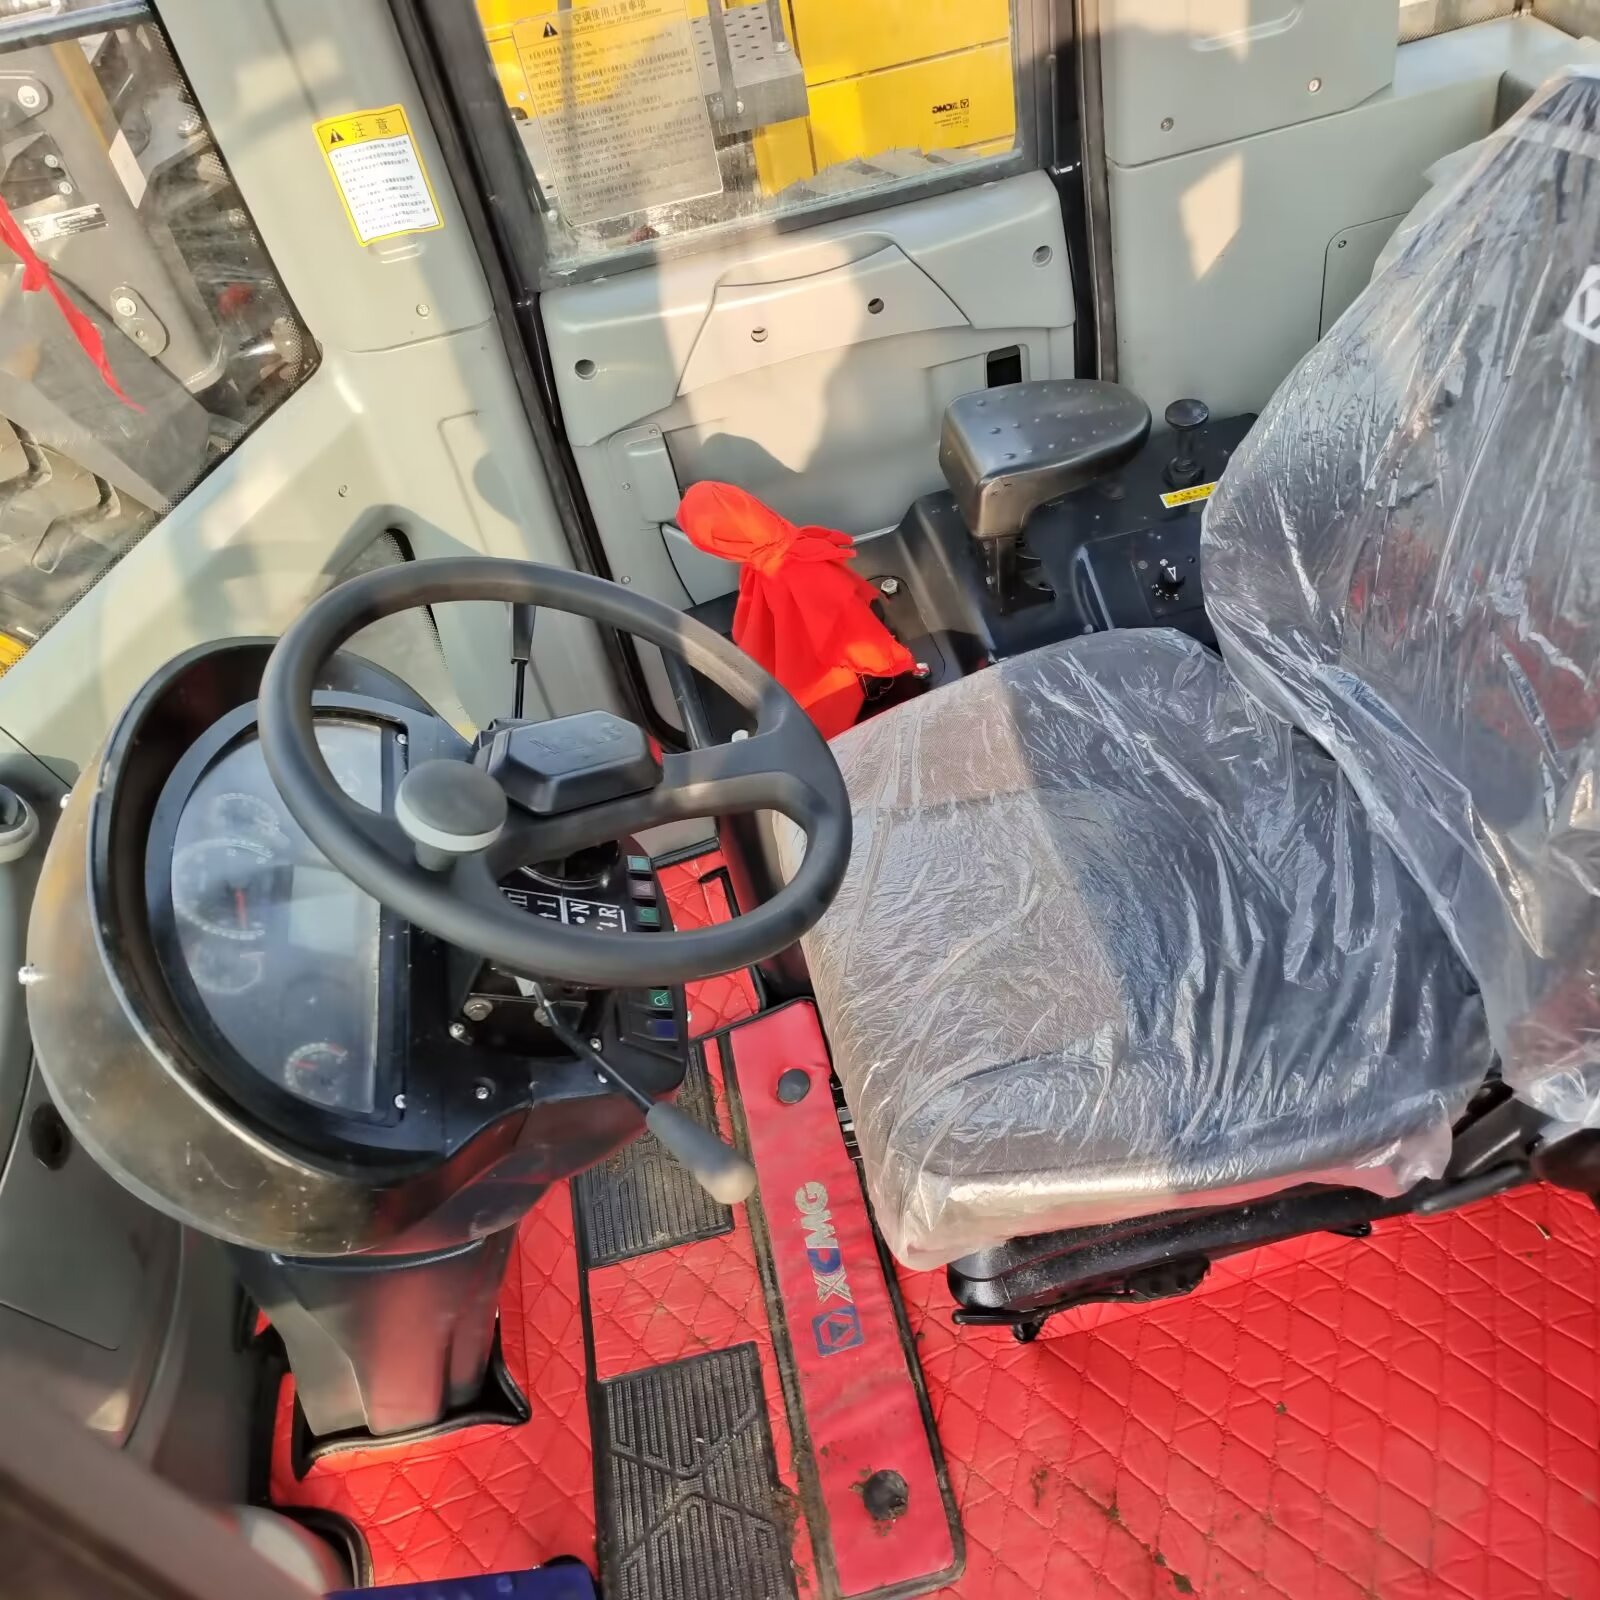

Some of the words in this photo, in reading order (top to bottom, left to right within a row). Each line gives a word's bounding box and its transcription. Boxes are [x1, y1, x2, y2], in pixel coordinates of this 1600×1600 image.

[570, 902, 590, 915] N
[599, 908, 617, 919] R
[795, 1181, 853, 1304] XCMG
